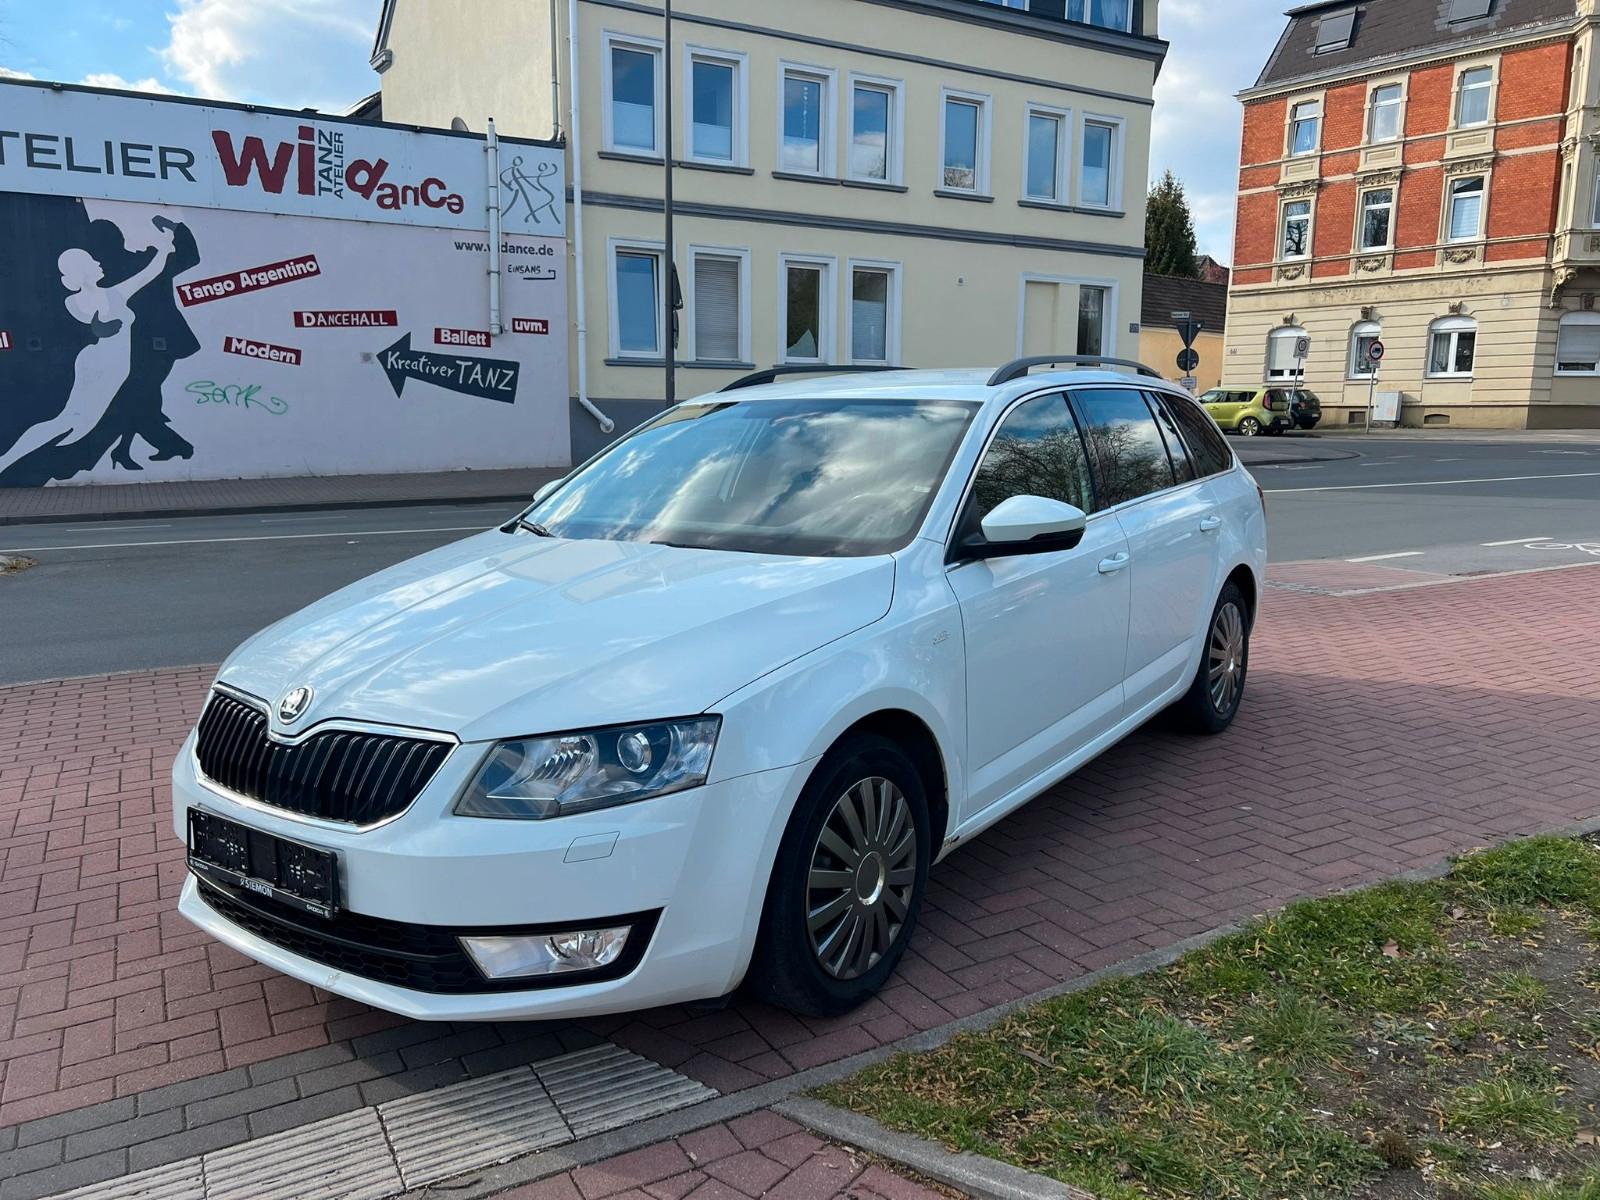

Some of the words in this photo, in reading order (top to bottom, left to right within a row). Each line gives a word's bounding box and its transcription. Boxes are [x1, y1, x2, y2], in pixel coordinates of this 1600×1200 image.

[318, 129, 333, 197] TANZ
[333, 131, 344, 200] ATELIER
[454, 240, 554, 256] www.idance.de
[181, 280, 236, 302] Tango
[240, 259, 318, 288] Argentino
[302, 311, 389, 327] DANCEHALL
[514, 320, 547, 332] uvm.
[230, 337, 297, 364] Modern
[440, 329, 487, 346] Ballett
[387, 350, 456, 377] Kreativer
[455, 359, 515, 391] TANZ
